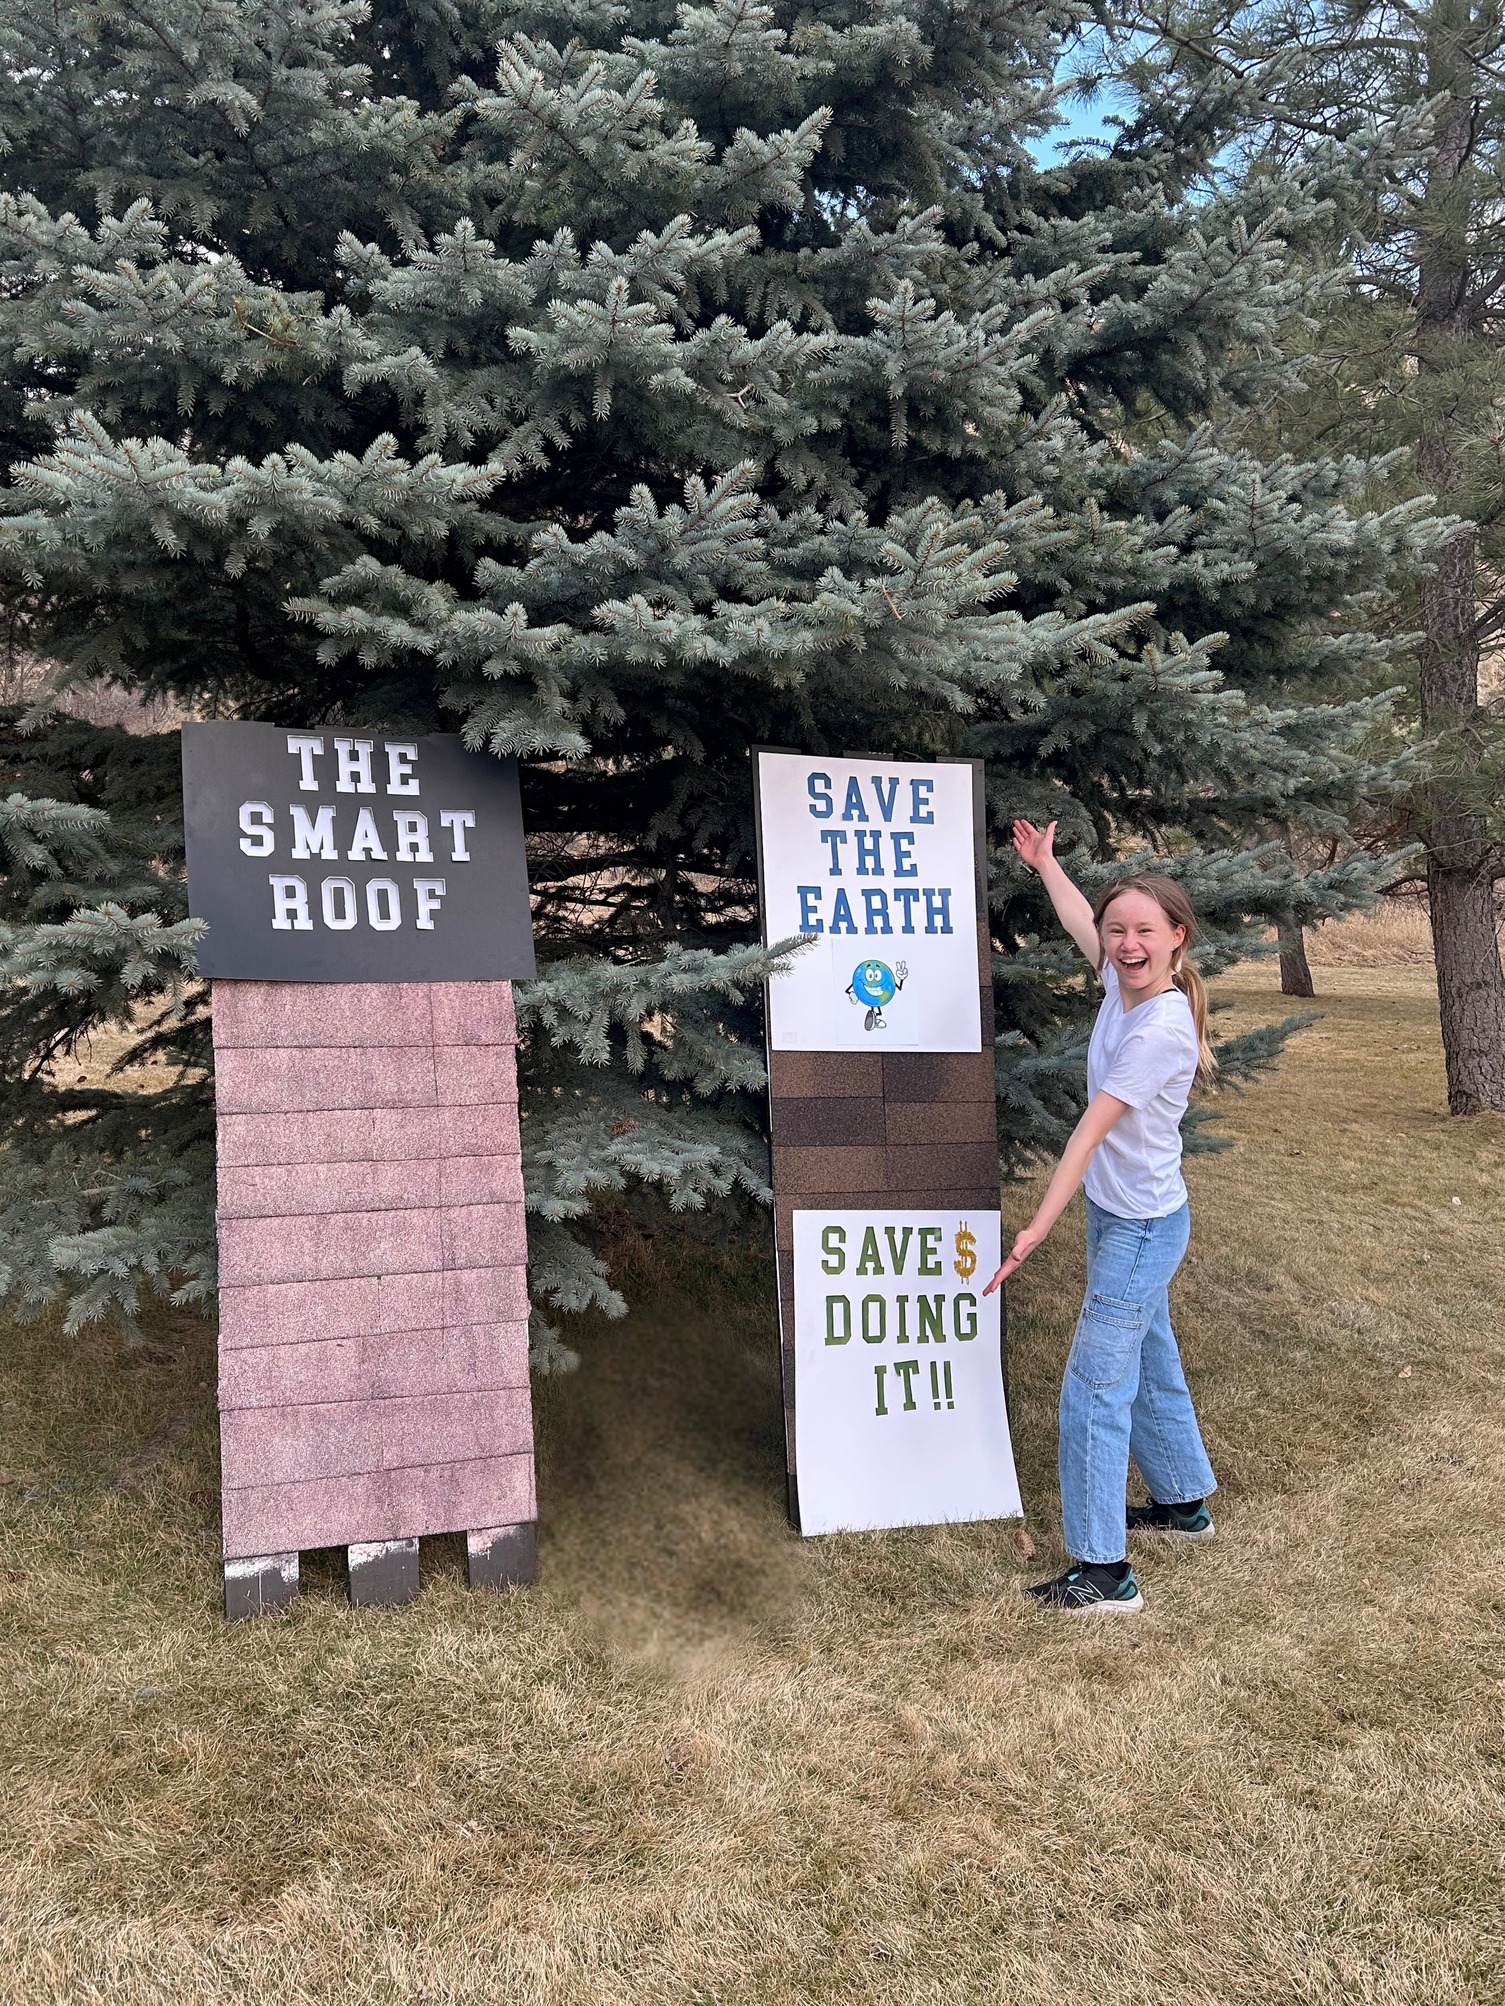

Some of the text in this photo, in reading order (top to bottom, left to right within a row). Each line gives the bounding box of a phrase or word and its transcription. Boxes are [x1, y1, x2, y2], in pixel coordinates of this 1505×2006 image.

[287, 735, 420, 795] THE
[807, 772, 934, 824] SAVE
[238, 801, 476, 862] SMART
[820, 830, 918, 877] THE
[269, 874, 446, 931] ROOF
[797, 886, 953, 934] EARTH
[824, 1293, 977, 1346] DOING
[874, 1360, 954, 1416] IT!!
